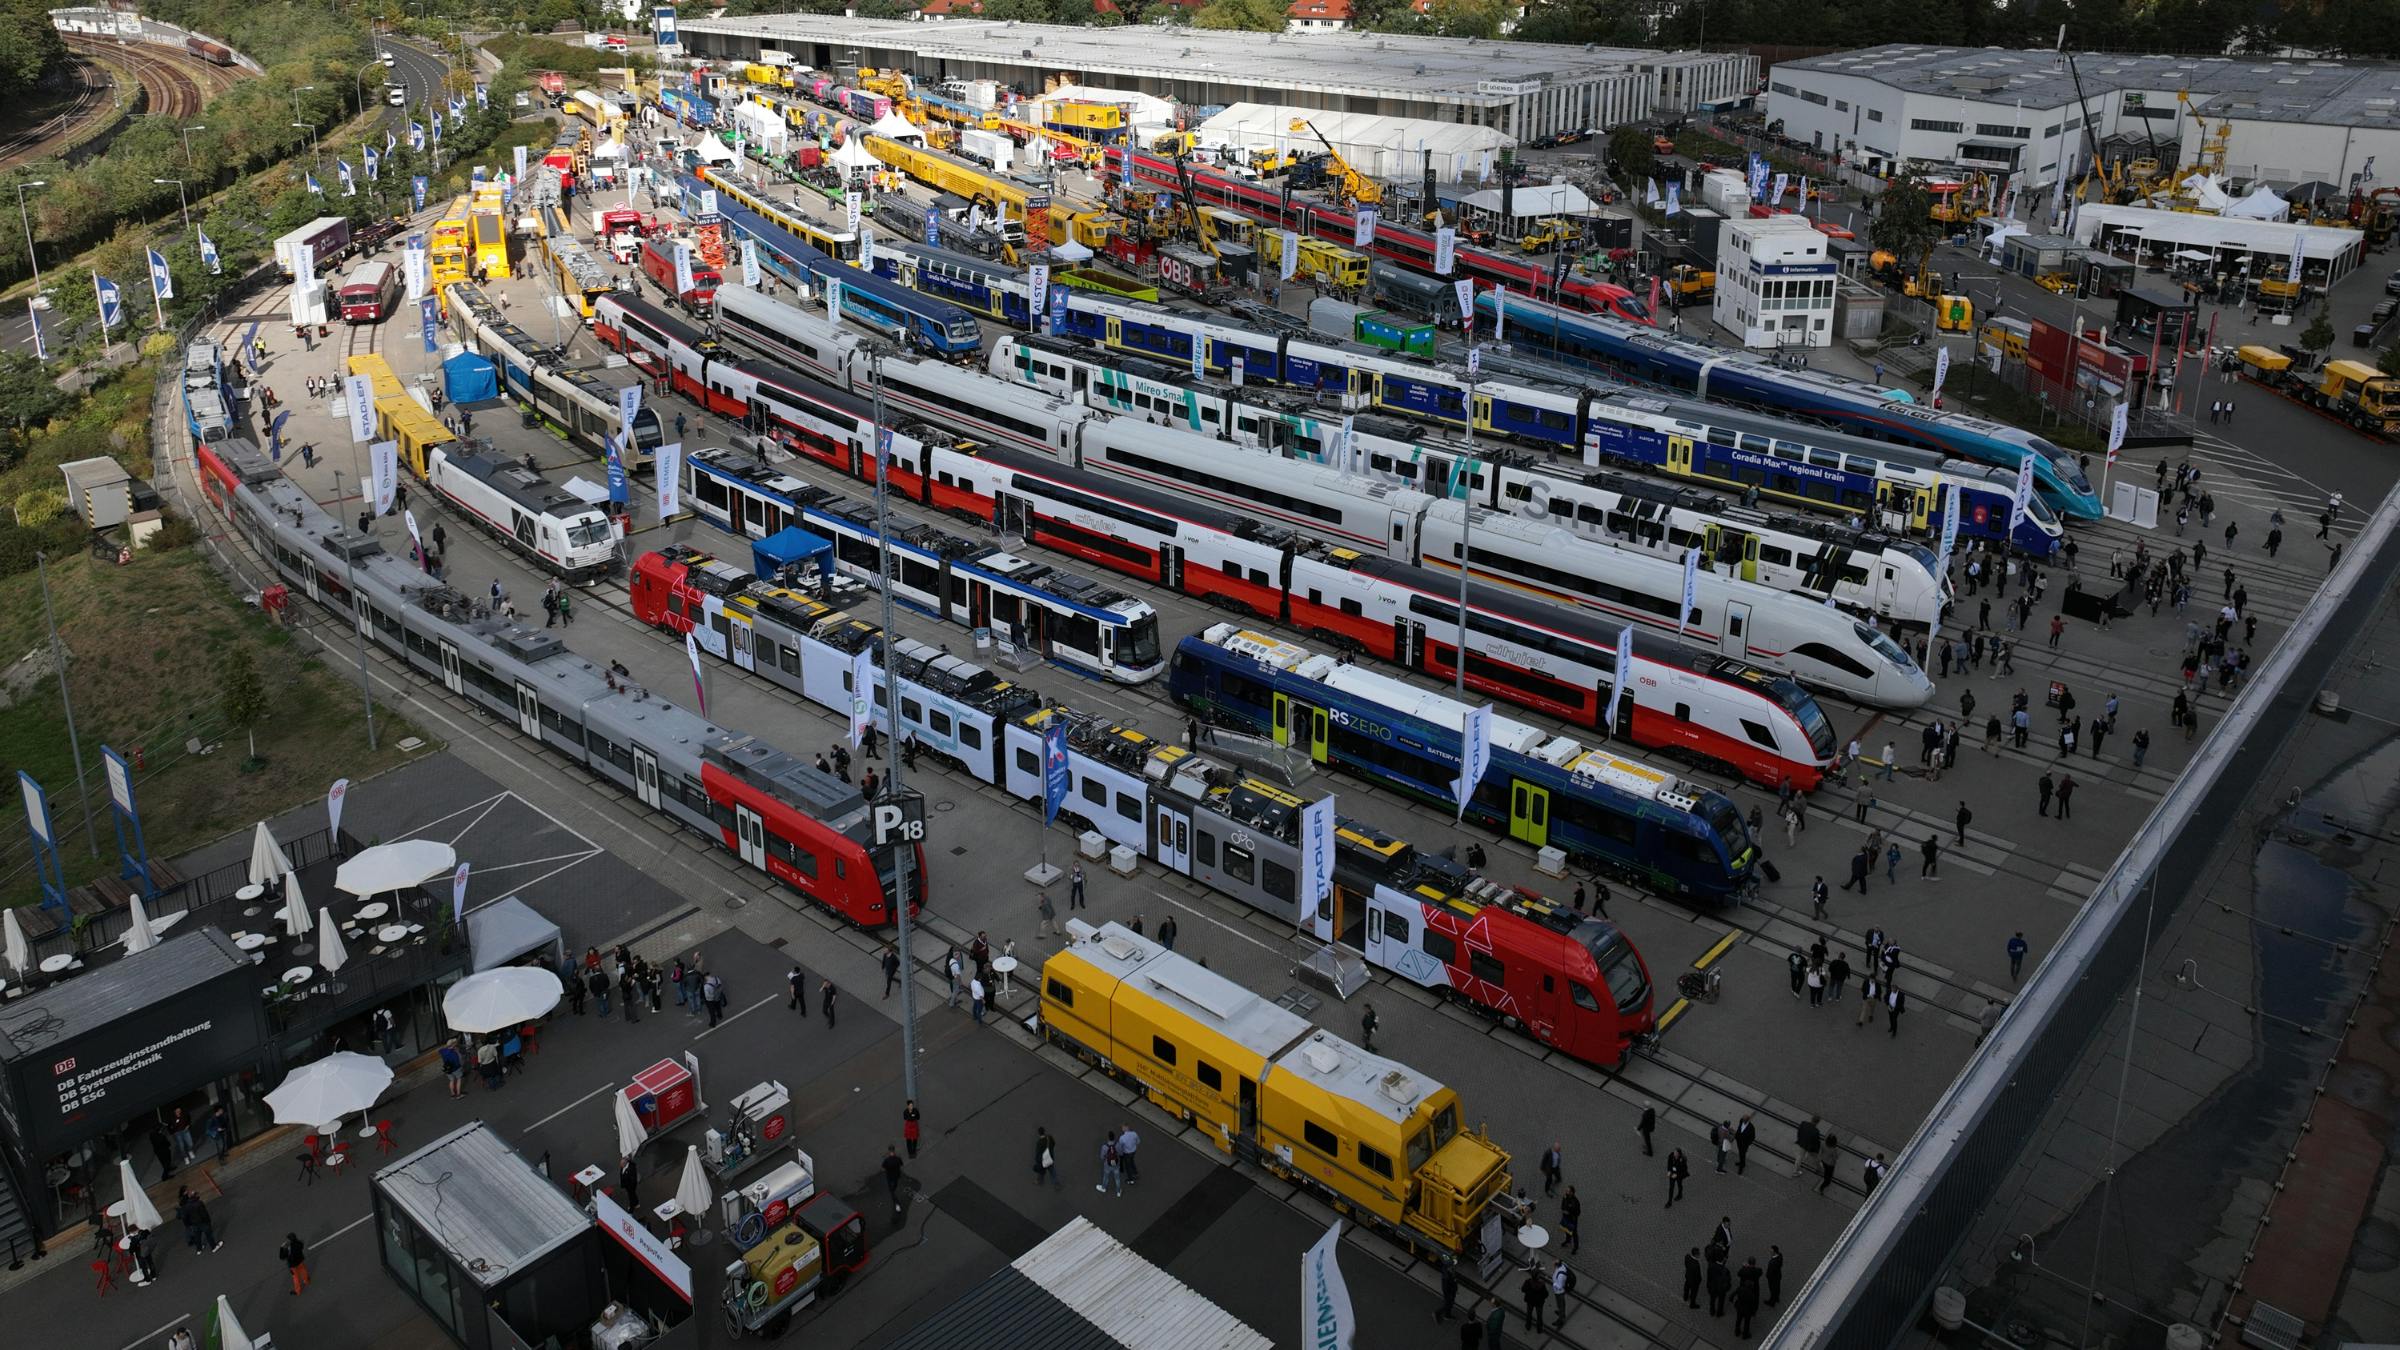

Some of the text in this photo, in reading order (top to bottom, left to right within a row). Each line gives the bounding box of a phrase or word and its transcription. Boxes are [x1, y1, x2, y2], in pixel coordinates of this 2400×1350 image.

[1033, 267, 1043, 312] ALSTOM
[1135, 380, 1161, 396] Mireo
[359, 379, 371, 437] STADLER
[663, 455, 671, 489] SIEMENS
[1731, 451, 1762, 466] Coradia
[1788, 464, 1824, 479] regional
[1823, 470, 1845, 483] train
[1944, 493, 1955, 553] SIEMENS
[1382, 596, 1397, 606] VOR
[1485, 642, 1546, 668] cityjet
[1328, 706, 1393, 742] RSZERO
[1427, 745, 1454, 762] BATTERY
[331, 784, 345, 801] DB
[1149, 795, 1155, 804] 2
[874, 804, 924, 846] P 18
[55, 1058, 77, 1075] DB
[57, 1019, 212, 1092] DB Fahrzeuginstandhaltung
[59, 1051, 163, 1104] DB Systemtechnik
[61, 1088, 106, 1114] DB ESG
[621, 1218, 635, 1240] DB
